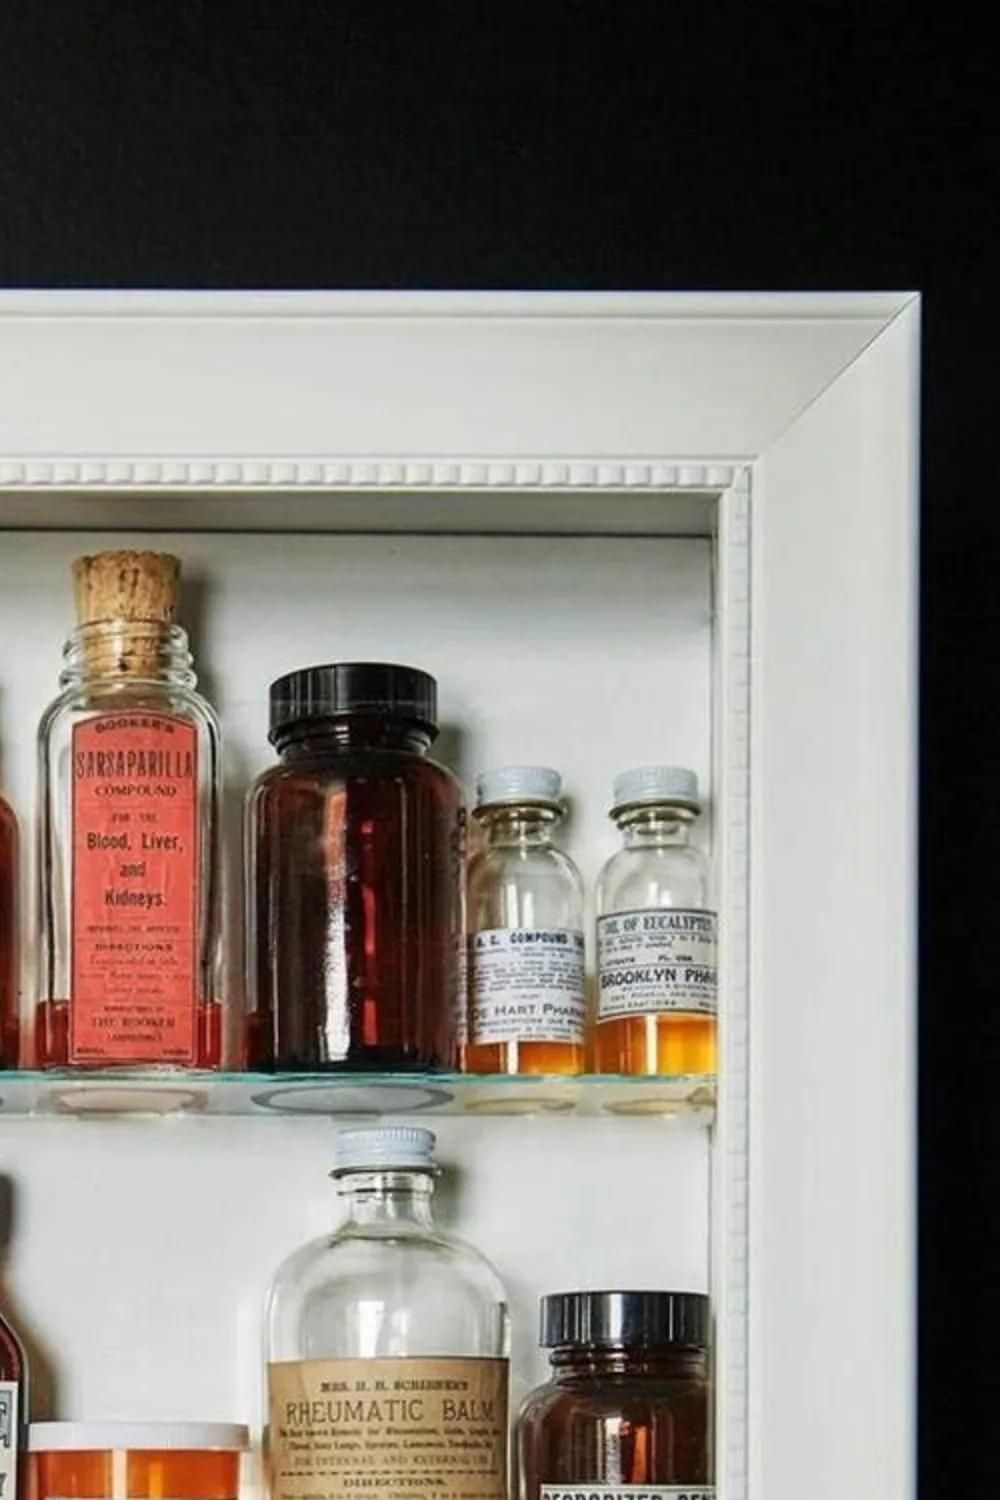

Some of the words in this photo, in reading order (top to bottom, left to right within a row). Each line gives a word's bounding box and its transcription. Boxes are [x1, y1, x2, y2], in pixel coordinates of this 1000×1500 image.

[75, 750, 194, 779] SARSAPARILLA
[94, 783, 178, 798] COMPOUND
[86, 830, 133, 852] Blood,
[140, 830, 184, 853] Liver,
[119, 861, 147, 879] and
[509, 931, 568, 946] COMPOUND
[600, 968, 677, 989] BROOKLYN
[494, 1004, 536, 1017] HART
[285, 1398, 425, 1426] RHEUMATIC
